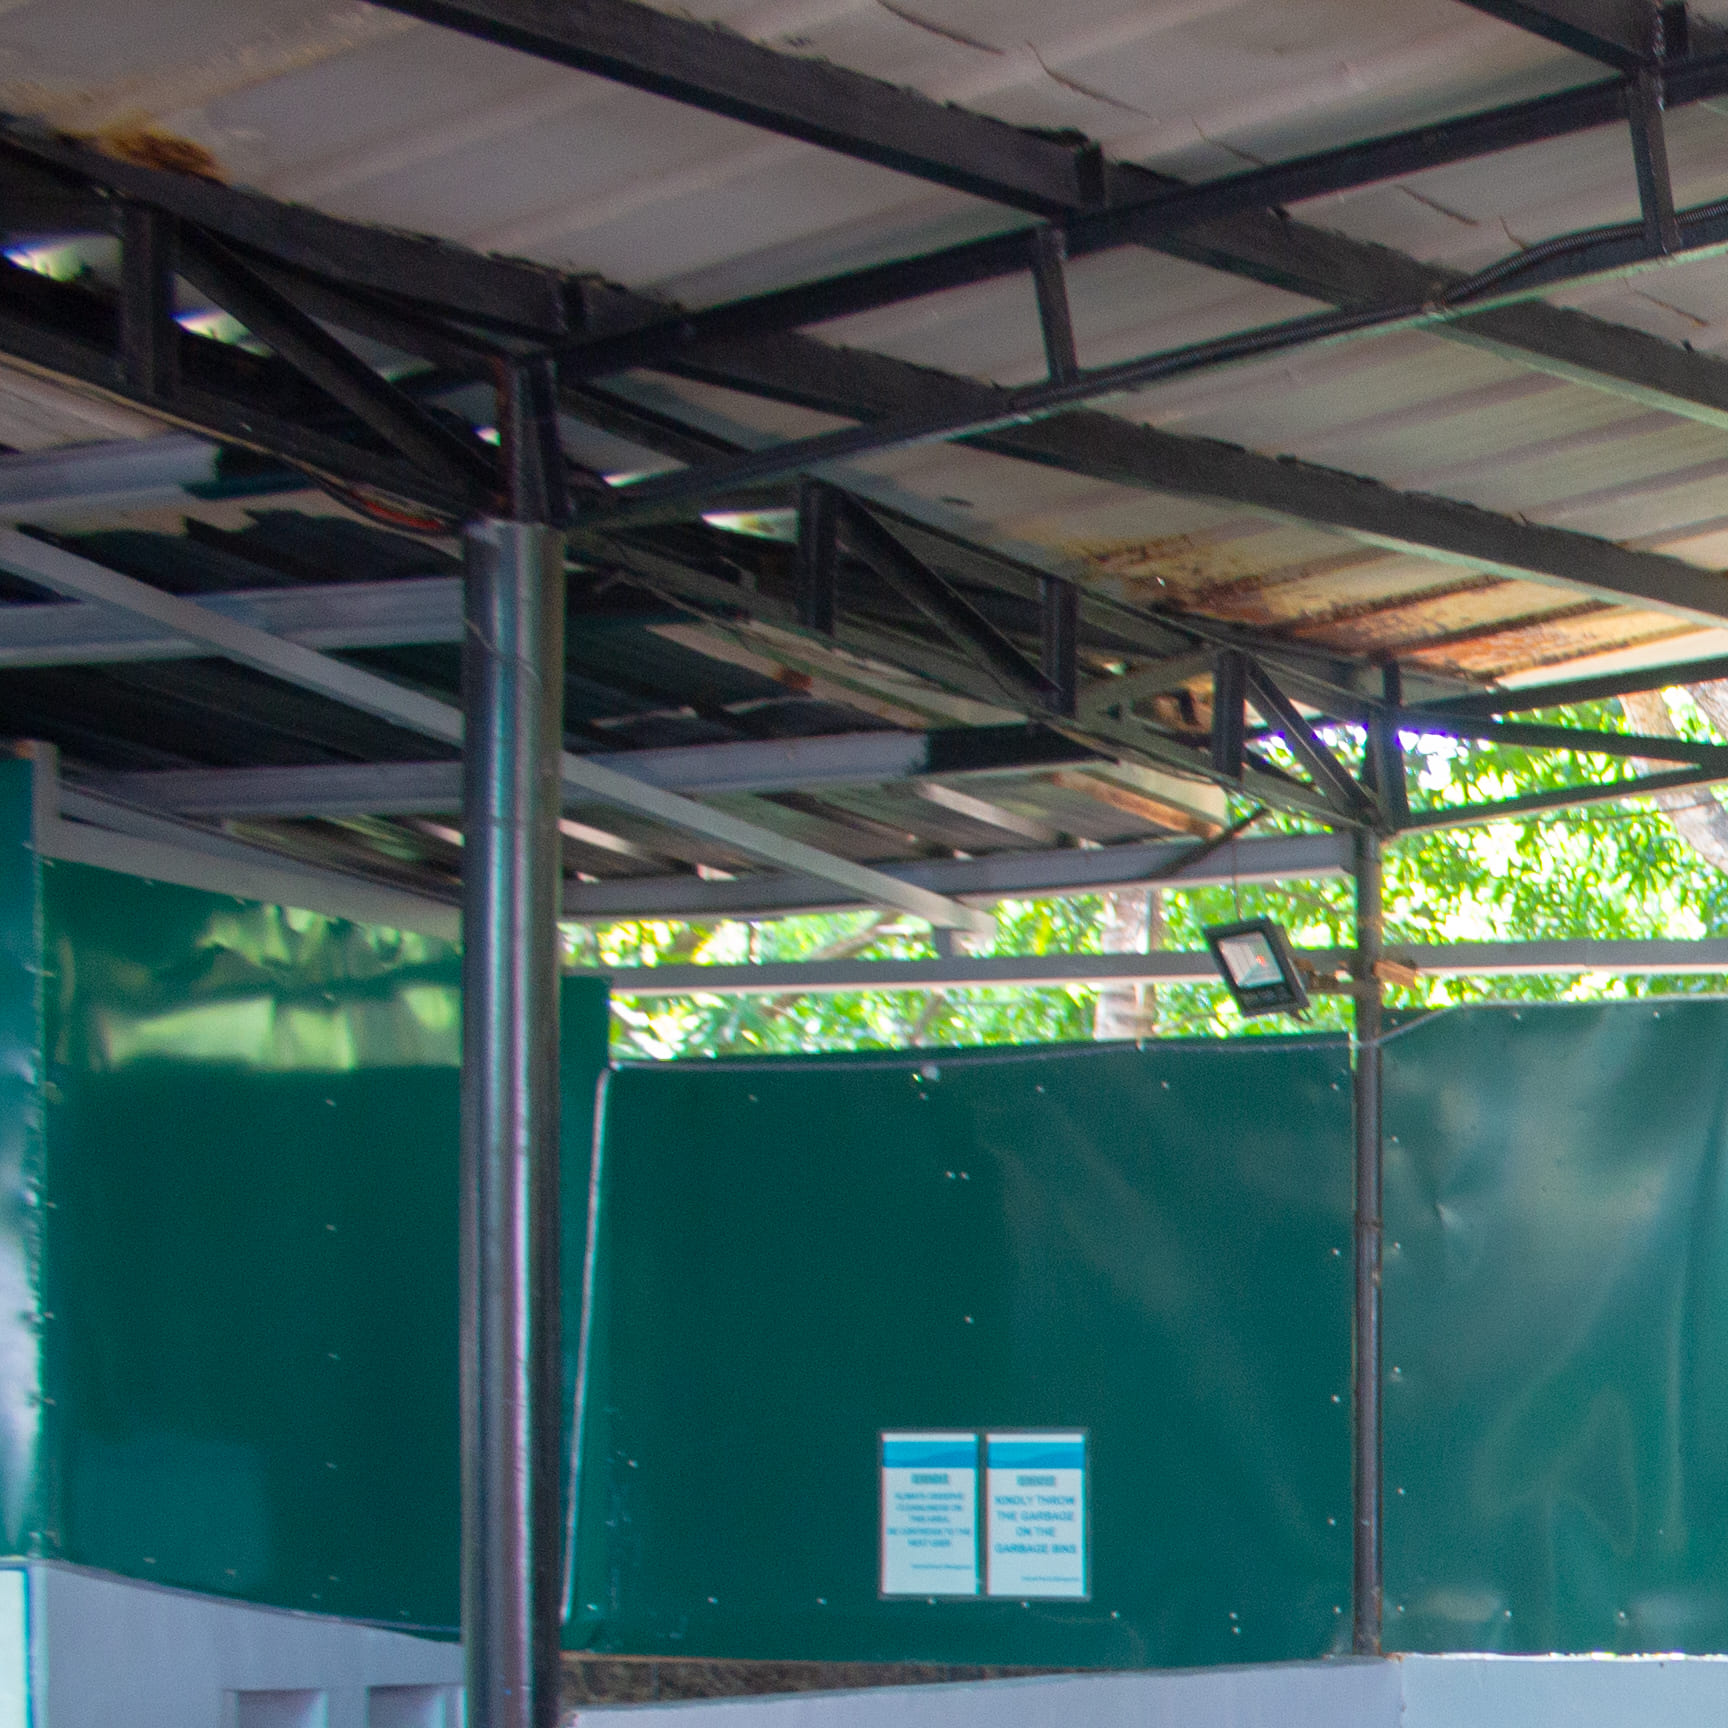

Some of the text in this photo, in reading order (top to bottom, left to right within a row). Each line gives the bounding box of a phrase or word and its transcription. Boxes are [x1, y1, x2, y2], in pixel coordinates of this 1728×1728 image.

[994, 1495, 1075, 1505] KINDLY THROW
[995, 1510, 1075, 1521] THE GARBAGE
[1015, 1526, 1056, 1537] ON THE
[994, 1543, 1048, 1554] GARBAGE
